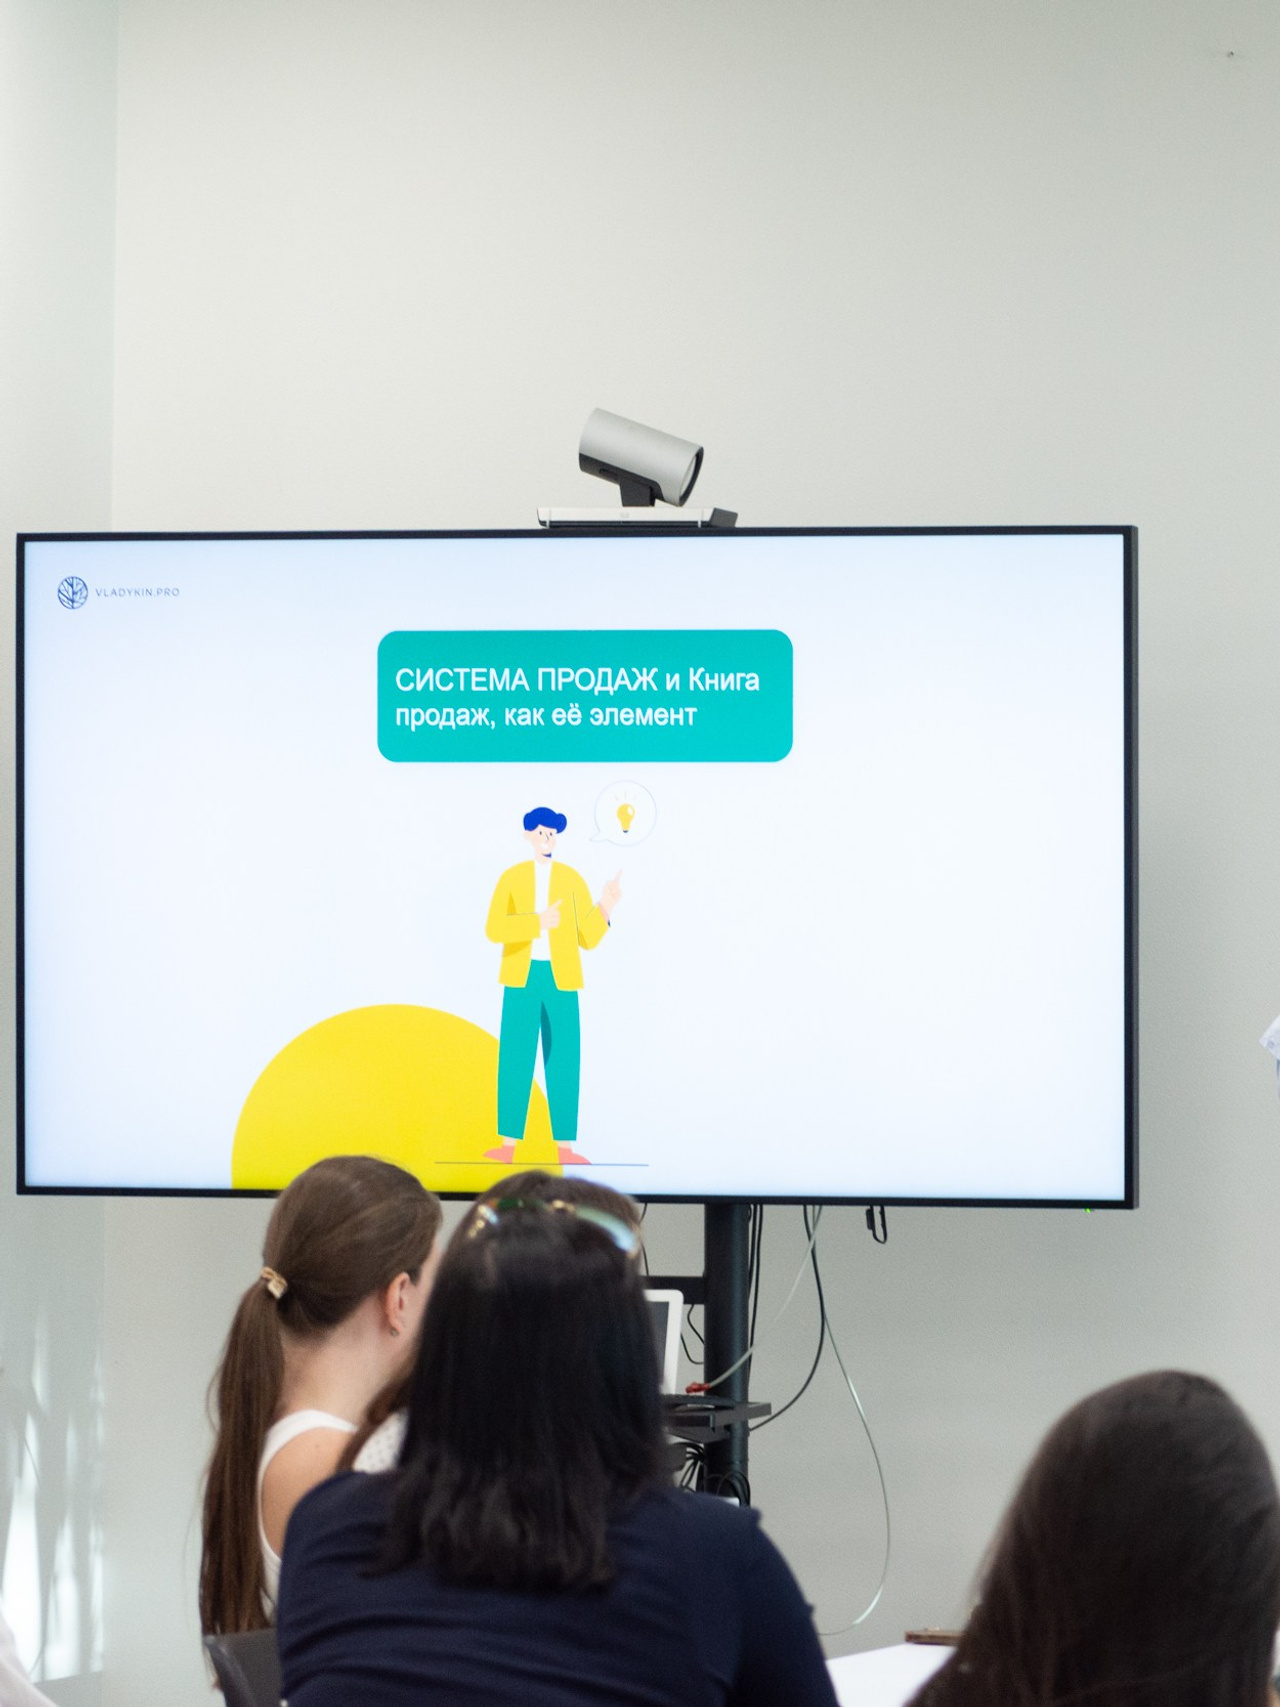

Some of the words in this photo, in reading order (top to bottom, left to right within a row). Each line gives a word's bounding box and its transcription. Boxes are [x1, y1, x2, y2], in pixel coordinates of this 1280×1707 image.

[95, 588, 180, 598] VLADYKIN.PRO
[395, 667, 530, 692] СИСТЕМА
[537, 667, 659, 696] ПРОДАЖ
[666, 672, 680, 691] и
[688, 667, 760, 692] Книга
[395, 706, 496, 731] продаж,
[504, 707, 545, 726] как
[551, 702, 583, 726] её
[589, 707, 698, 726] элемент
